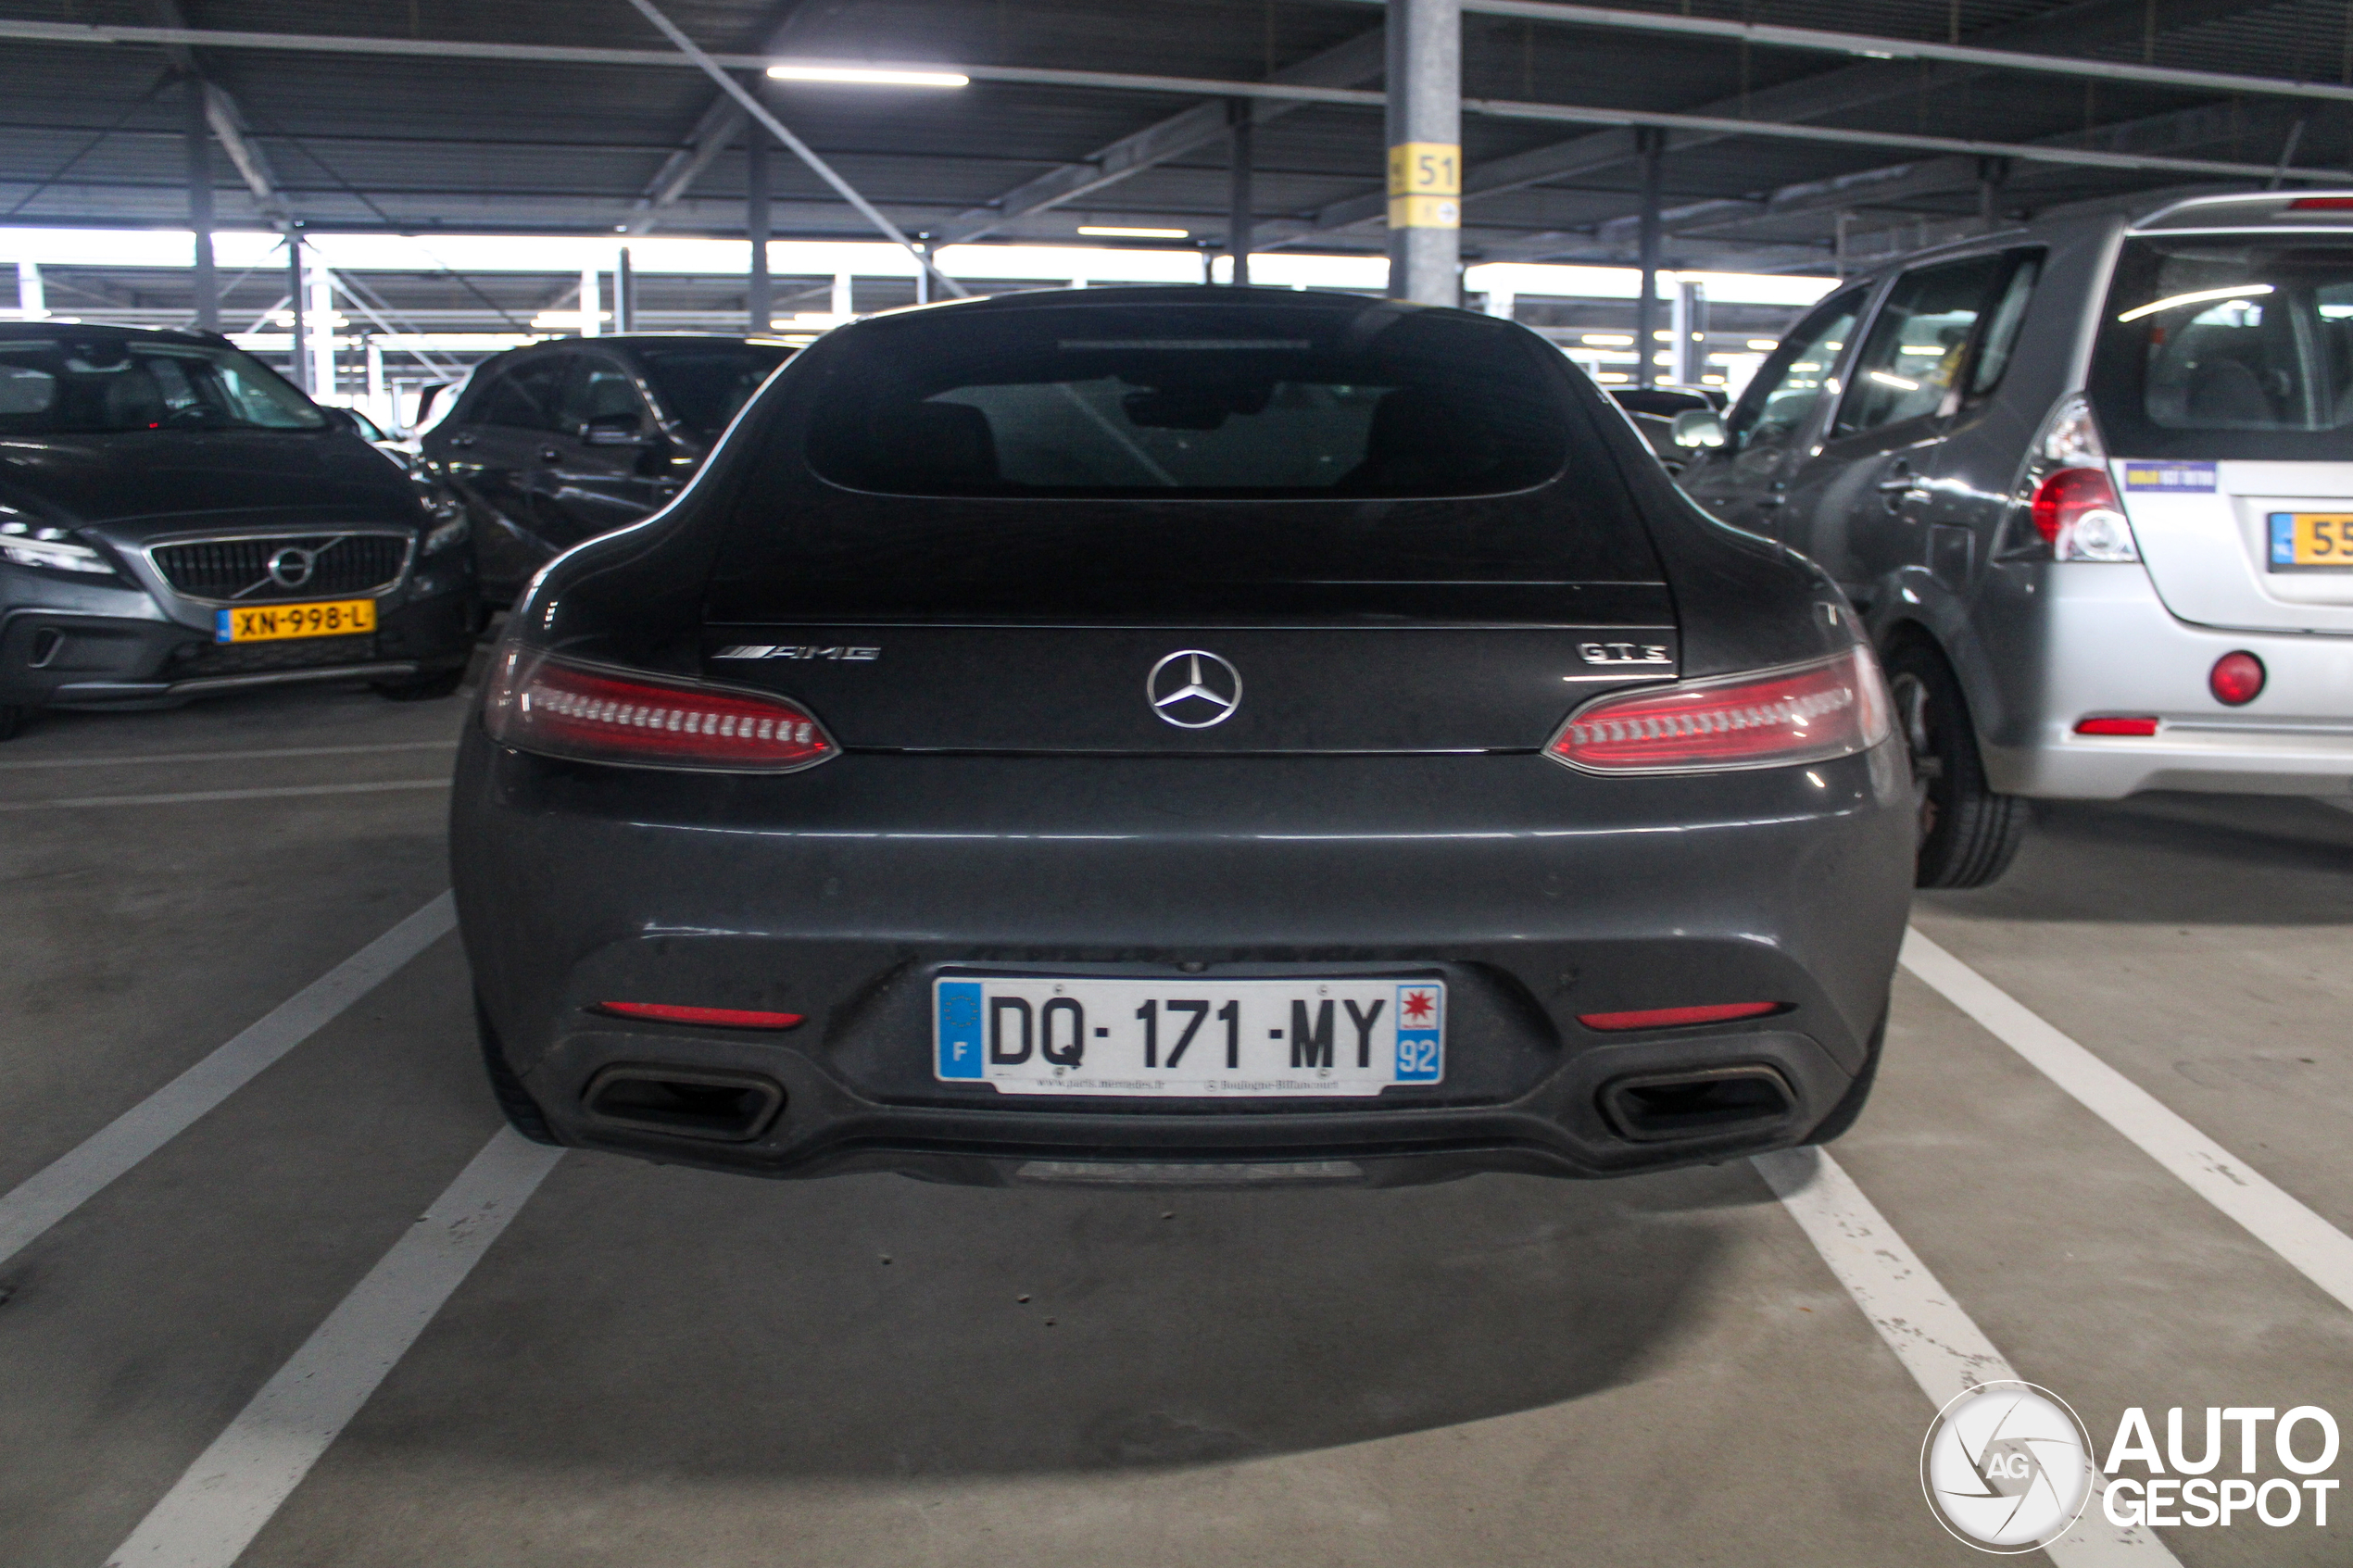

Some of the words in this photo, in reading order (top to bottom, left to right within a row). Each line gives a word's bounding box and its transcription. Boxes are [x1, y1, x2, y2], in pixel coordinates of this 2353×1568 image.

[1418, 154, 1453, 187] 51
[240, 606, 367, 637] XN-998-L
[761, 646, 882, 660] AMG
[952, 1041, 968, 1061] F
[1399, 1039, 1437, 1073] 92
